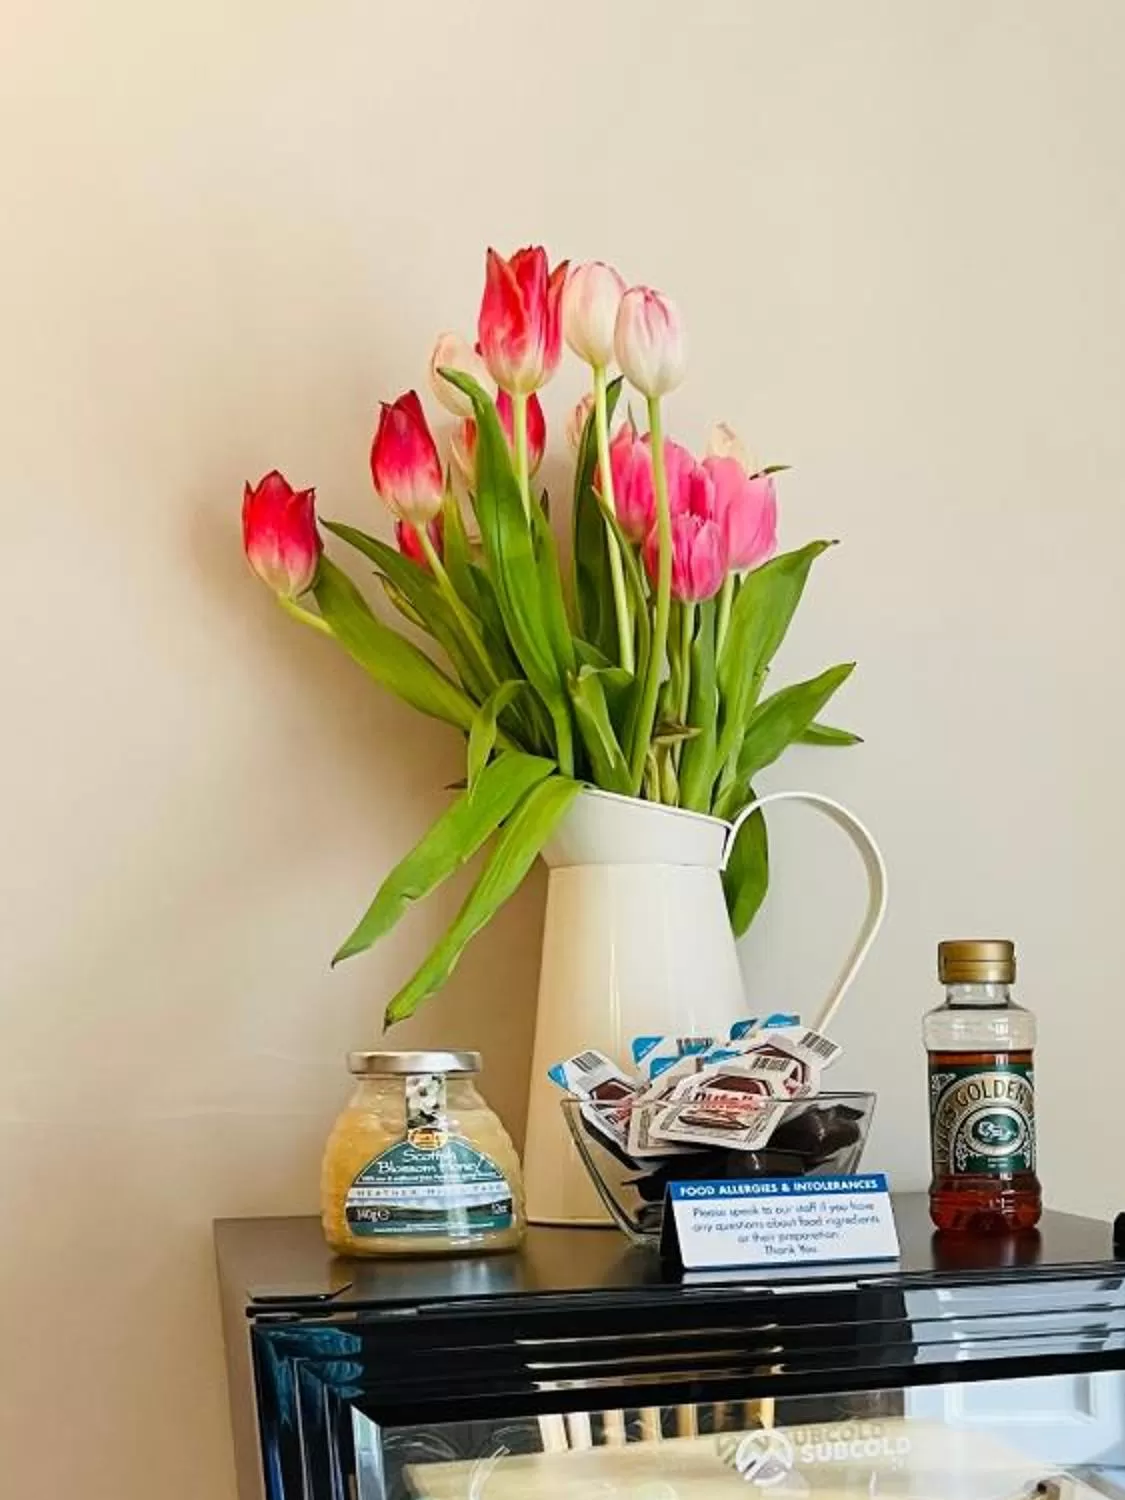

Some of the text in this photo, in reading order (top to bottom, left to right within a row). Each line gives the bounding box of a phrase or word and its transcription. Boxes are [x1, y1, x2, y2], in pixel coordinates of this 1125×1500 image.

[957, 1079, 1028, 1106] GOLDEN
[377, 1160, 437, 1175] Blossom
[680, 1179, 878, 1197] FOOD ALLERGIES & INTOLERANCES
[800, 1437, 912, 1464] SUBCOLD
